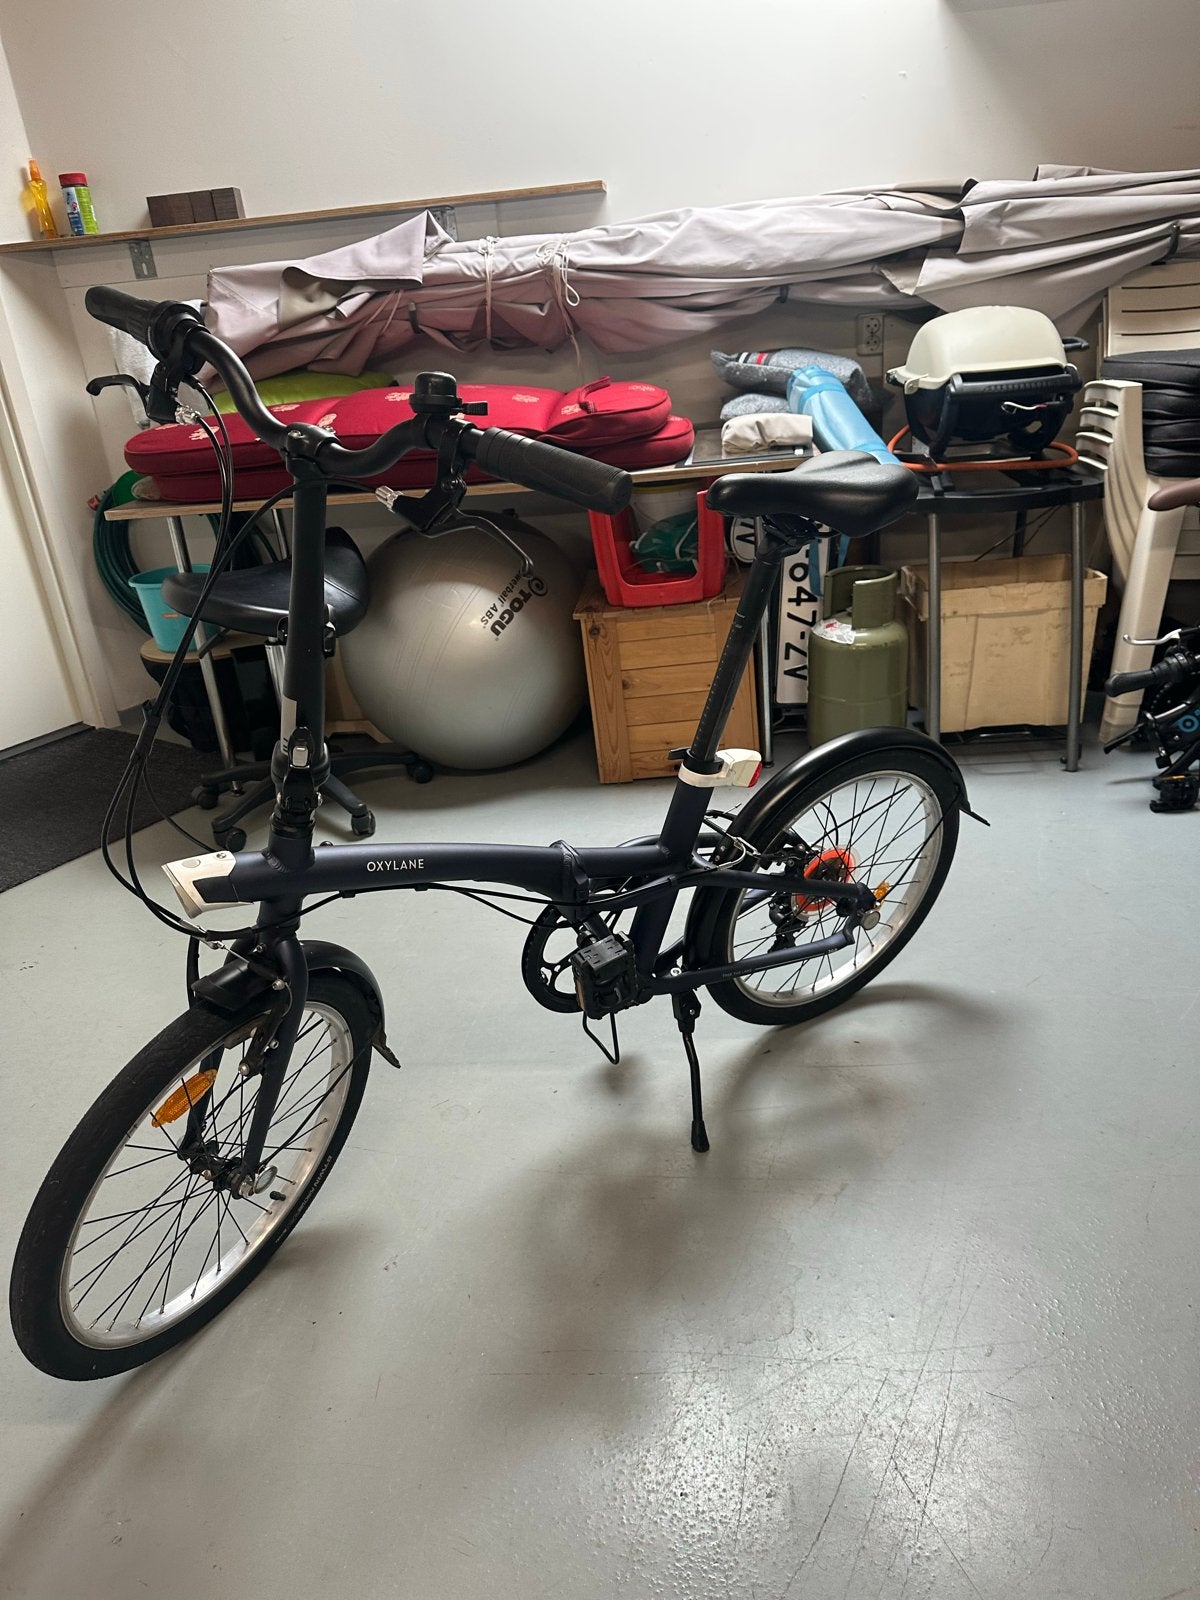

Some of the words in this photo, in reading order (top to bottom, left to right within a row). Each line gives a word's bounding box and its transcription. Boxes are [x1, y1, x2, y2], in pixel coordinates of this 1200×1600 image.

[481, 603, 498, 625] ABS
[490, 589, 532, 637] TOGU
[366, 858, 424, 872] OXYLANE
